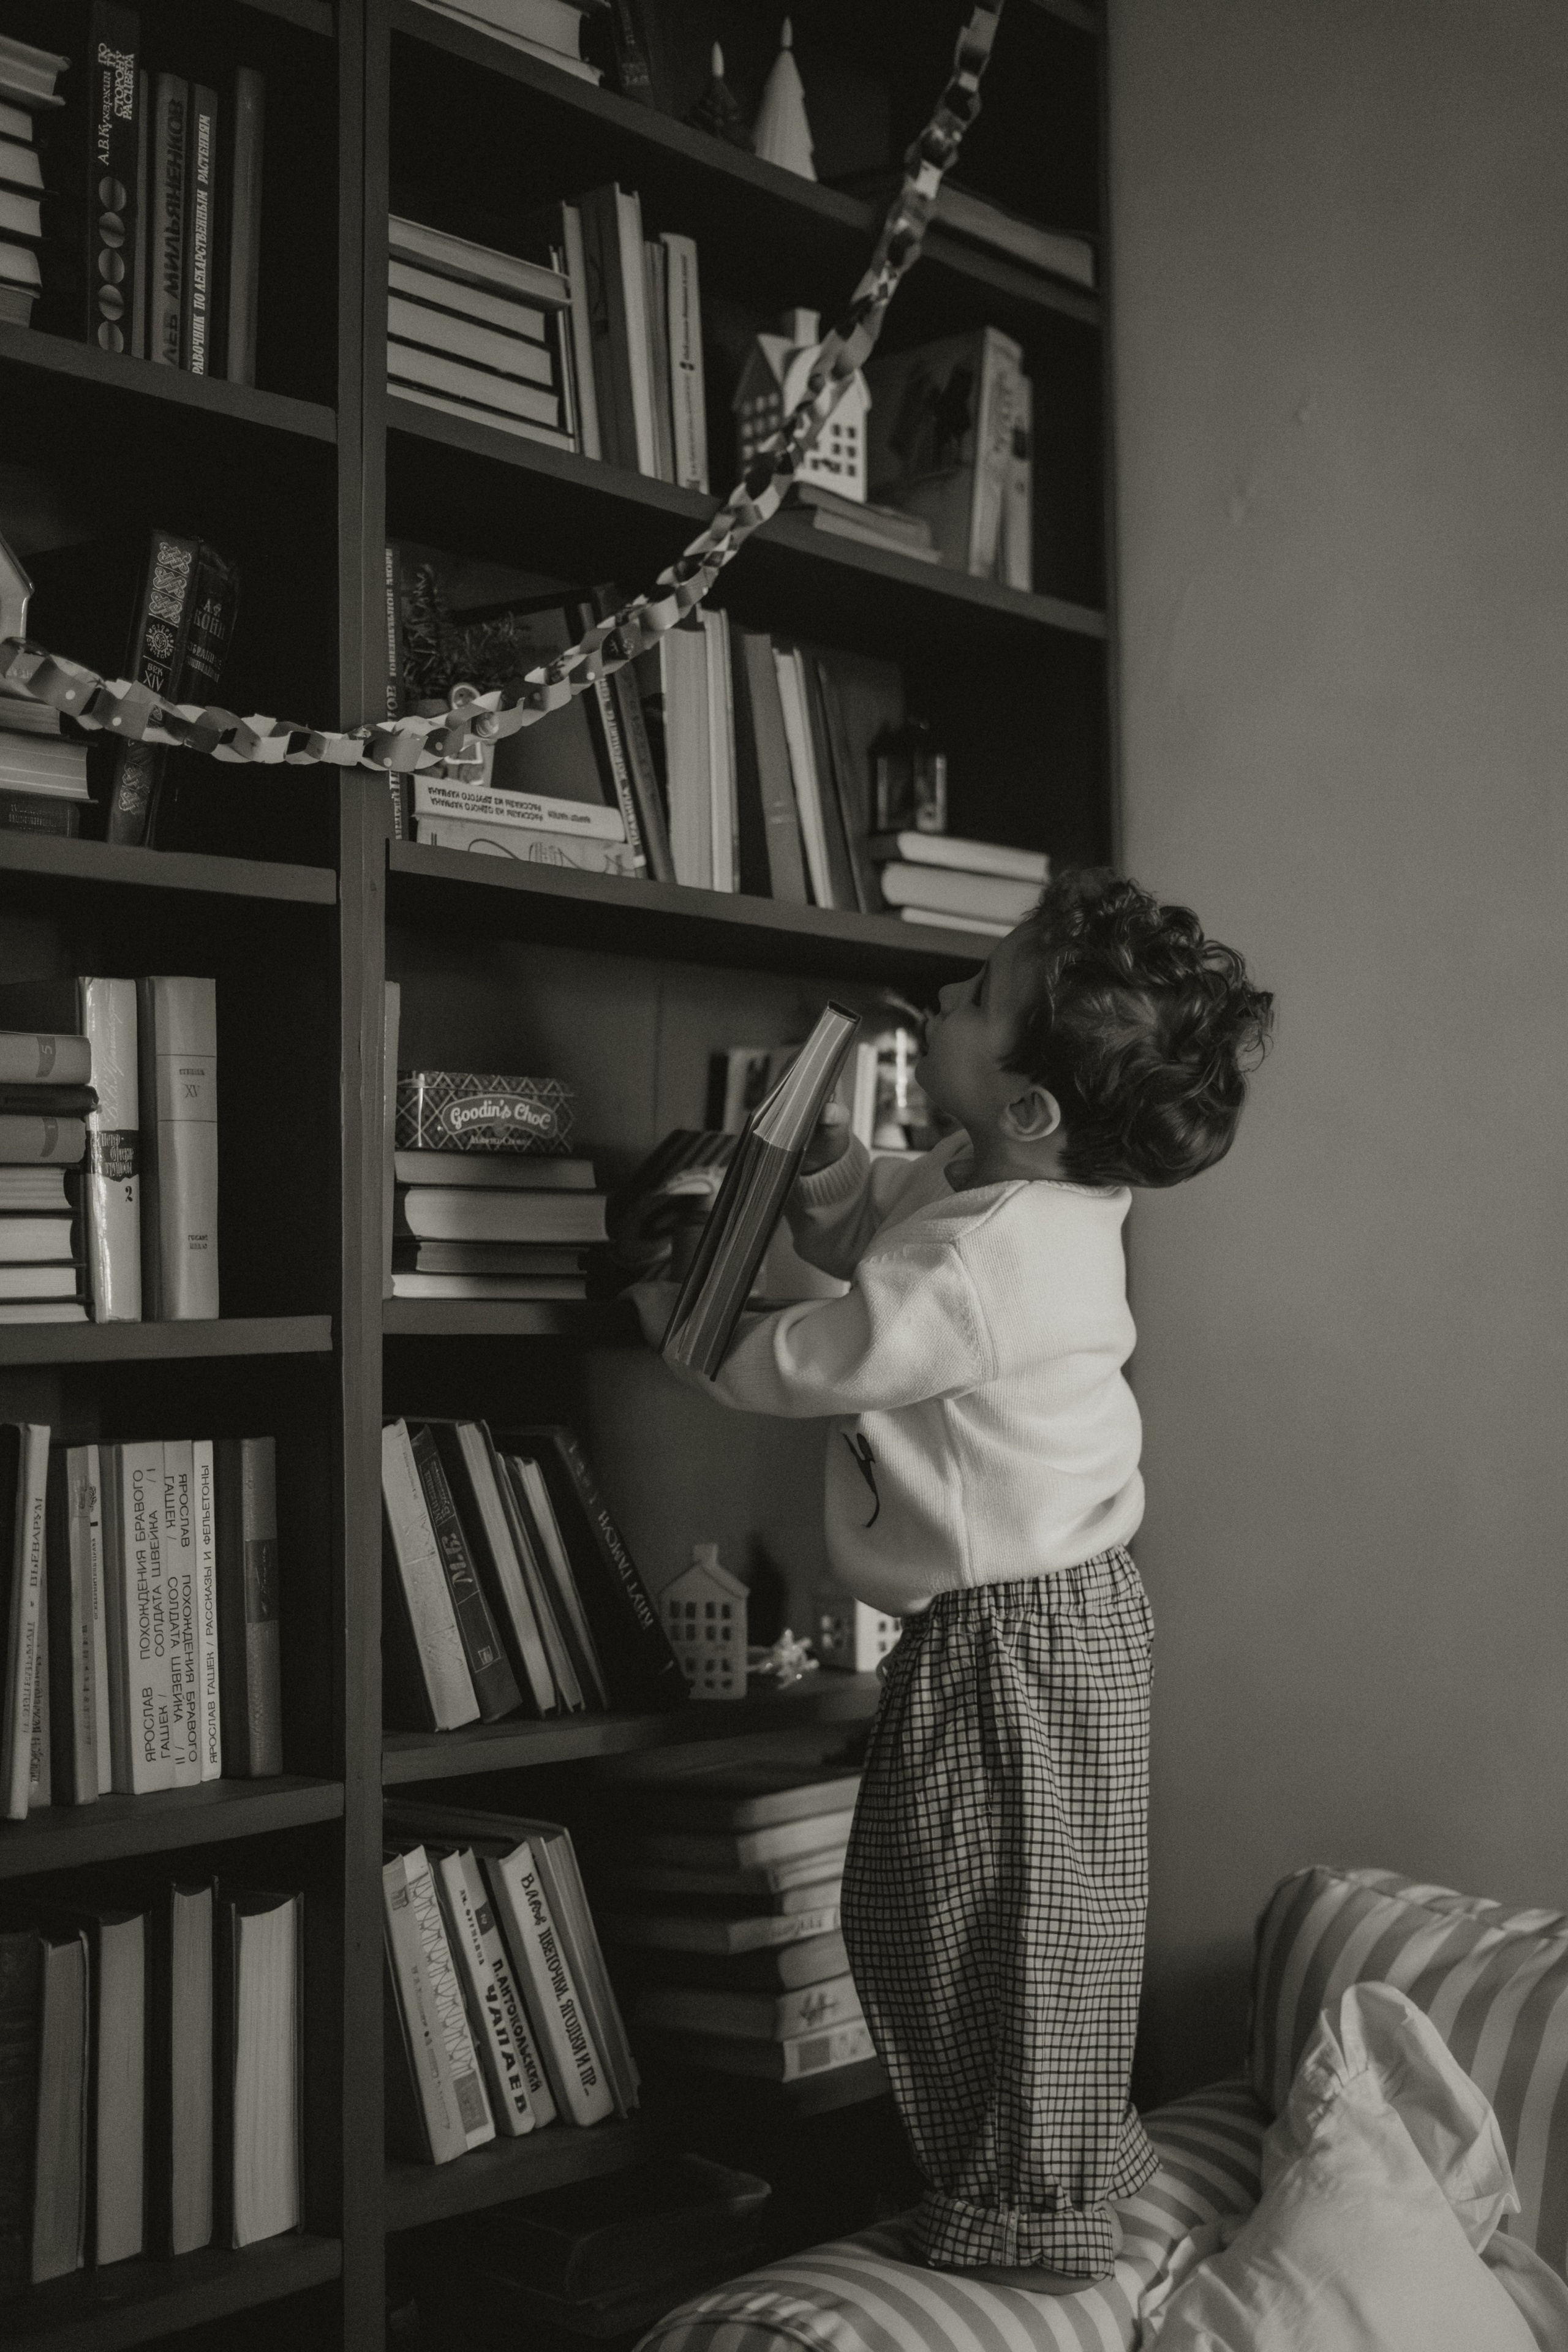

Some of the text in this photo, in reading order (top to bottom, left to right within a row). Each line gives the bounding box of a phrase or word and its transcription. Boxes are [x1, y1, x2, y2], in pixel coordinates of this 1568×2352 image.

[98, 42, 107, 65] ПО
[107, 48, 116, 67] ТУ
[114, 50, 124, 117] СТОРОНУ
[123, 53, 135, 120] РАСЦВЕТА
[192, 113, 210, 375] РАВОЧНИК ПО ЛЕКАРСТВЕННЫМ РАСТЕНИЯМ
[193, 608, 226, 640] КОНИ
[143, 670, 164, 692] XIV
[427, 786, 541, 812] РАССКАЗЫ ИЗ ДРУГОГО КАРМАНА
[429, 796, 543, 822] РАССКАЗЫ ИЗ ОДНОГО КАРМАНА
[41, 1045, 53, 1055] 5
[184, 1084, 201, 1099] XV
[450, 1099, 512, 1130] Goodin's
[124, 1185, 134, 1202] 2
[164, 1475, 177, 1529] ГАШЕК
[178, 1472, 190, 1548] ЯРОСЛАВ
[200, 1464, 213, 1545] ФЕЛЬЕТОНЫ
[29, 1496, 43, 1588] ВЬЕВАРУМ
[132, 1469, 151, 1660] ПОХОЖДЕНИЯ БРАВОГО
[146, 1509, 162, 1578] ШВЕЙКА
[202, 1550, 213, 1560] И
[597, 1509, 634, 1581] ГАМСУН
[152, 1588, 165, 1658] СОЛДАТА
[167, 1576, 181, 1648] СОЛДАТА
[203, 1566, 214, 1637] РАССКАЗЫ
[170, 1656, 185, 1724] ШВЕЙКА
[181, 1574, 198, 1763] ПОХОЖДЕНИЯ БРАВОГО
[205, 1652, 216, 1696] ГАШЕК
[141, 1687, 157, 1763] ЯРОСЛАВ
[158, 1705, 171, 1760] ГАШЕК
[206, 1700, 218, 1763] ЯРОСЛАВ
[486, 1984, 528, 2114] ЧАПАЕВ
[559, 1998, 588, 2056] ЯГОДКИ
[575, 2052, 591, 2069] И
